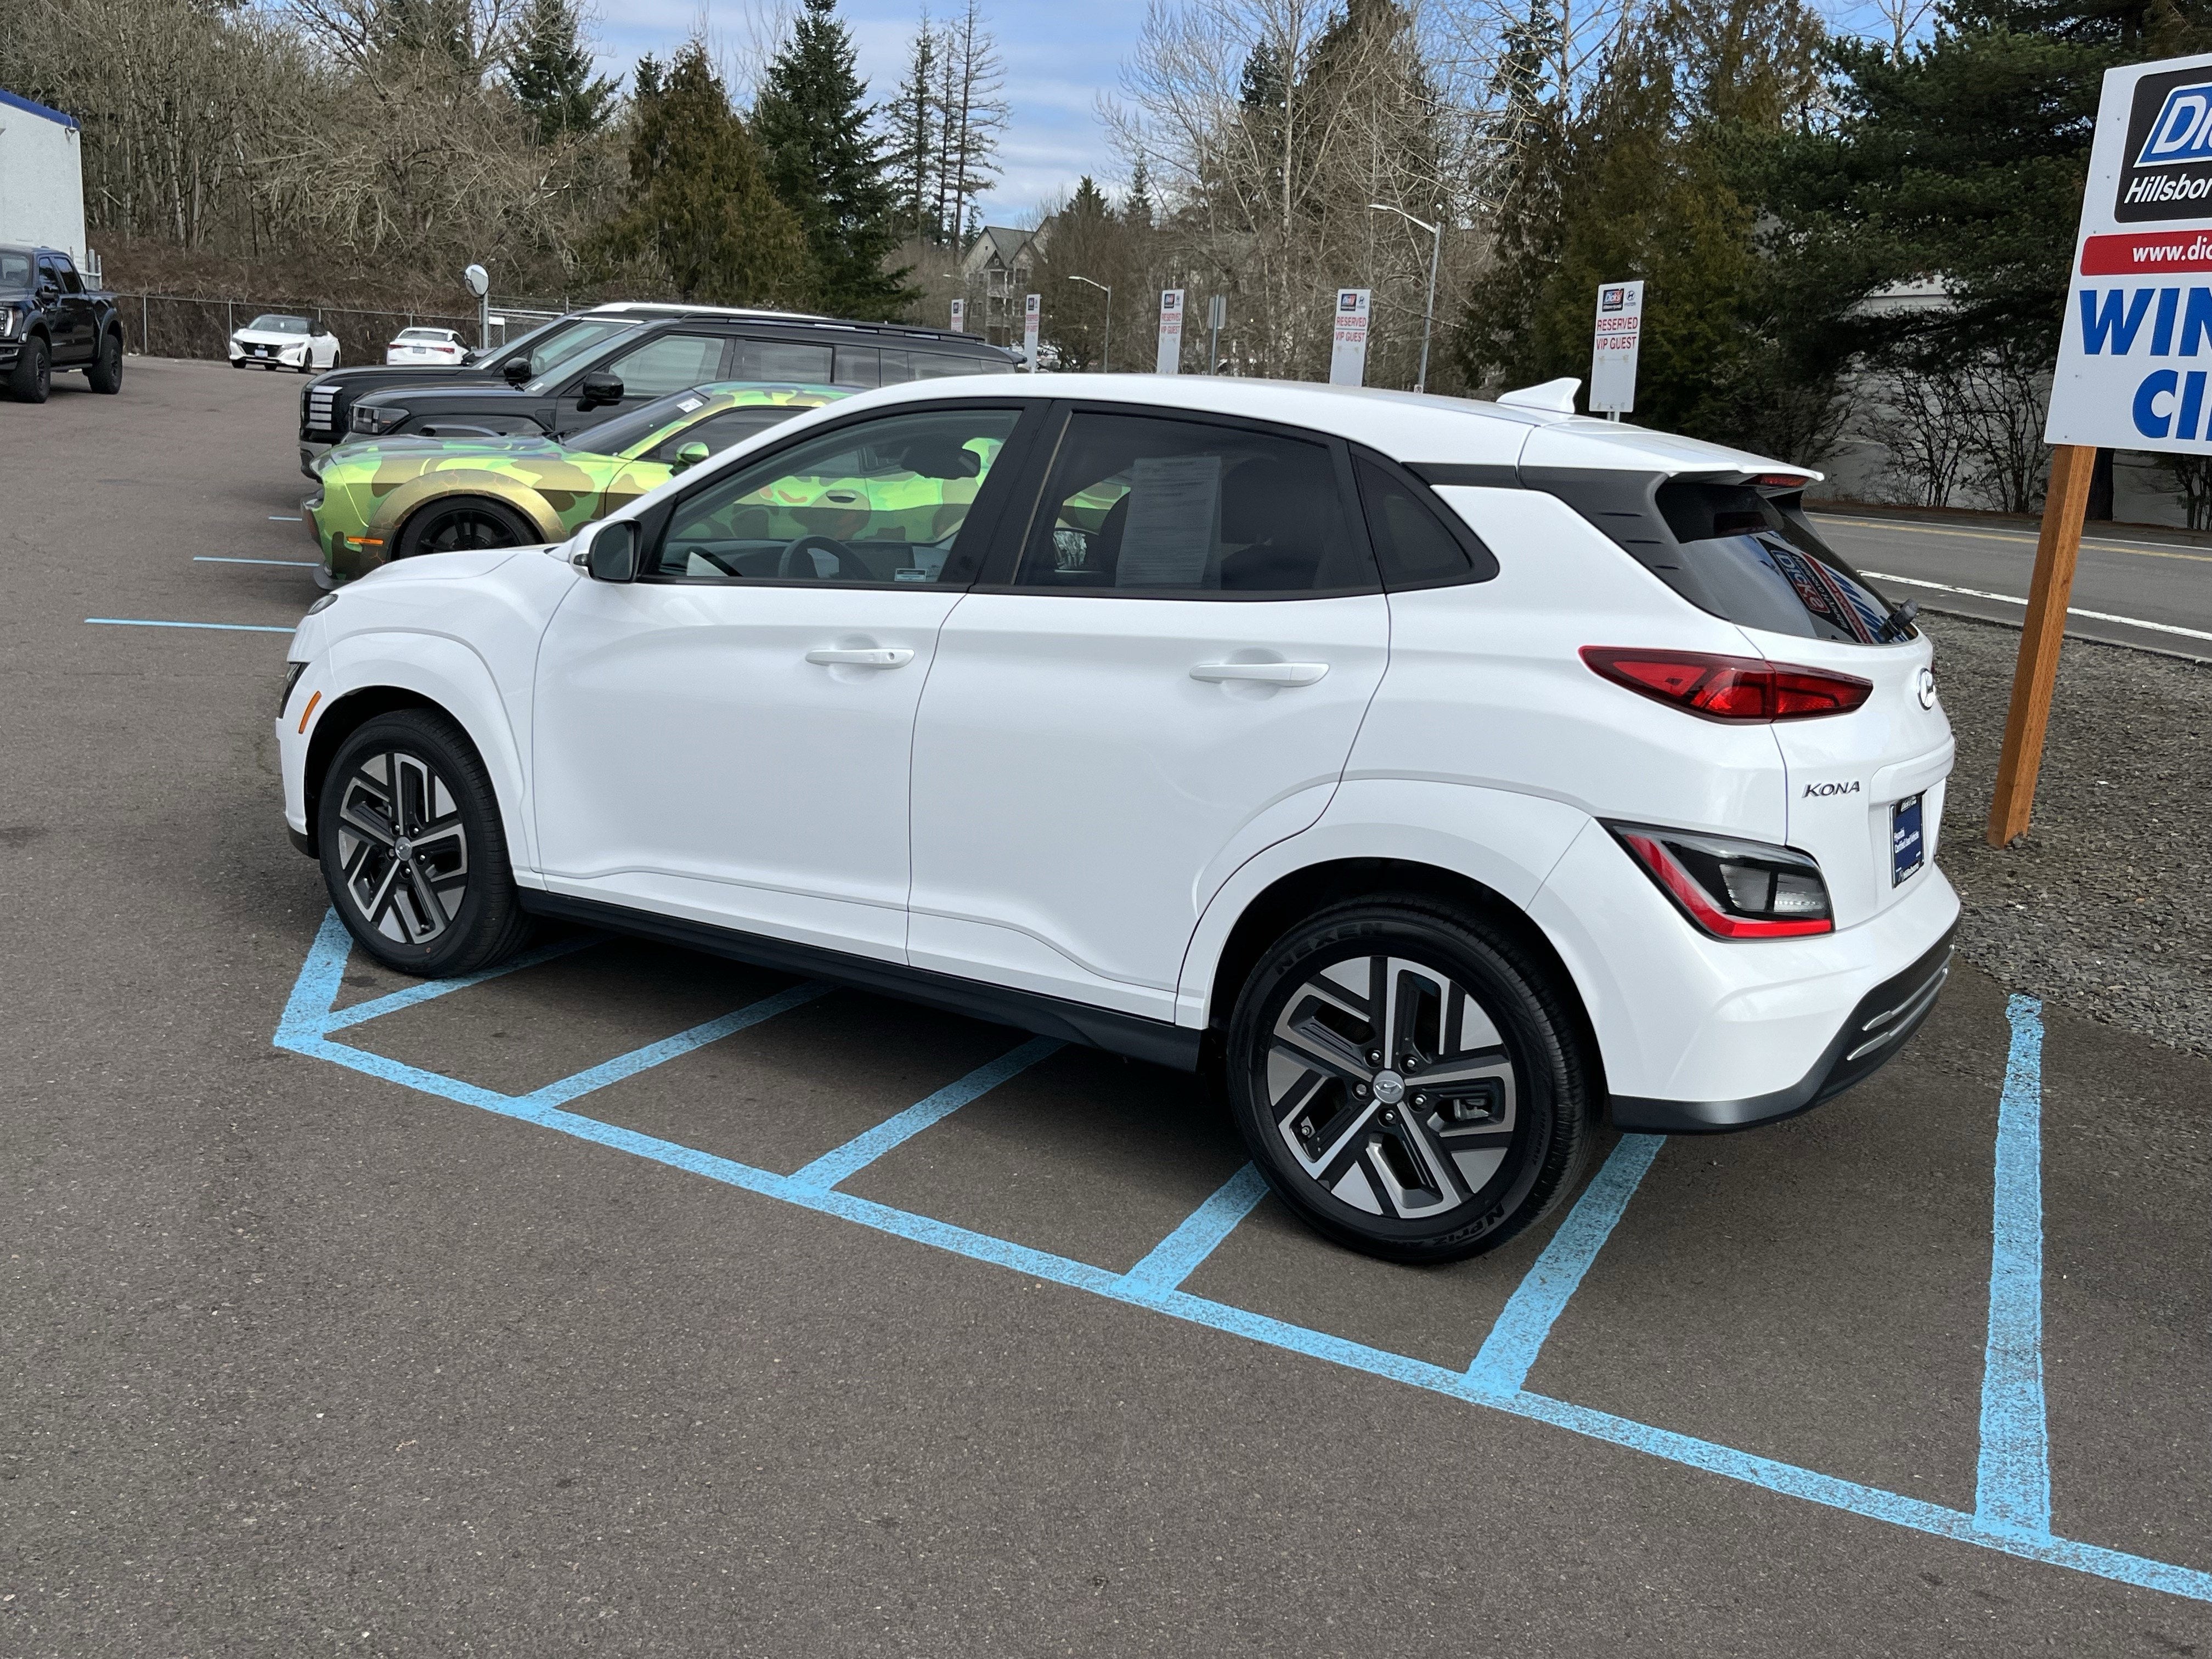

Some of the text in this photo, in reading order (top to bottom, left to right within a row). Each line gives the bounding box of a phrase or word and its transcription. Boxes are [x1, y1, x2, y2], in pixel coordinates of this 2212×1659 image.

[1336, 317, 1366, 327] RESERVED
[1597, 317, 1638, 331] RESERVED
[1335, 332, 1365, 342] VIP GUEST
[1596, 336, 1637, 350] VIP GUEST
[1802, 781, 1860, 798] KONA
